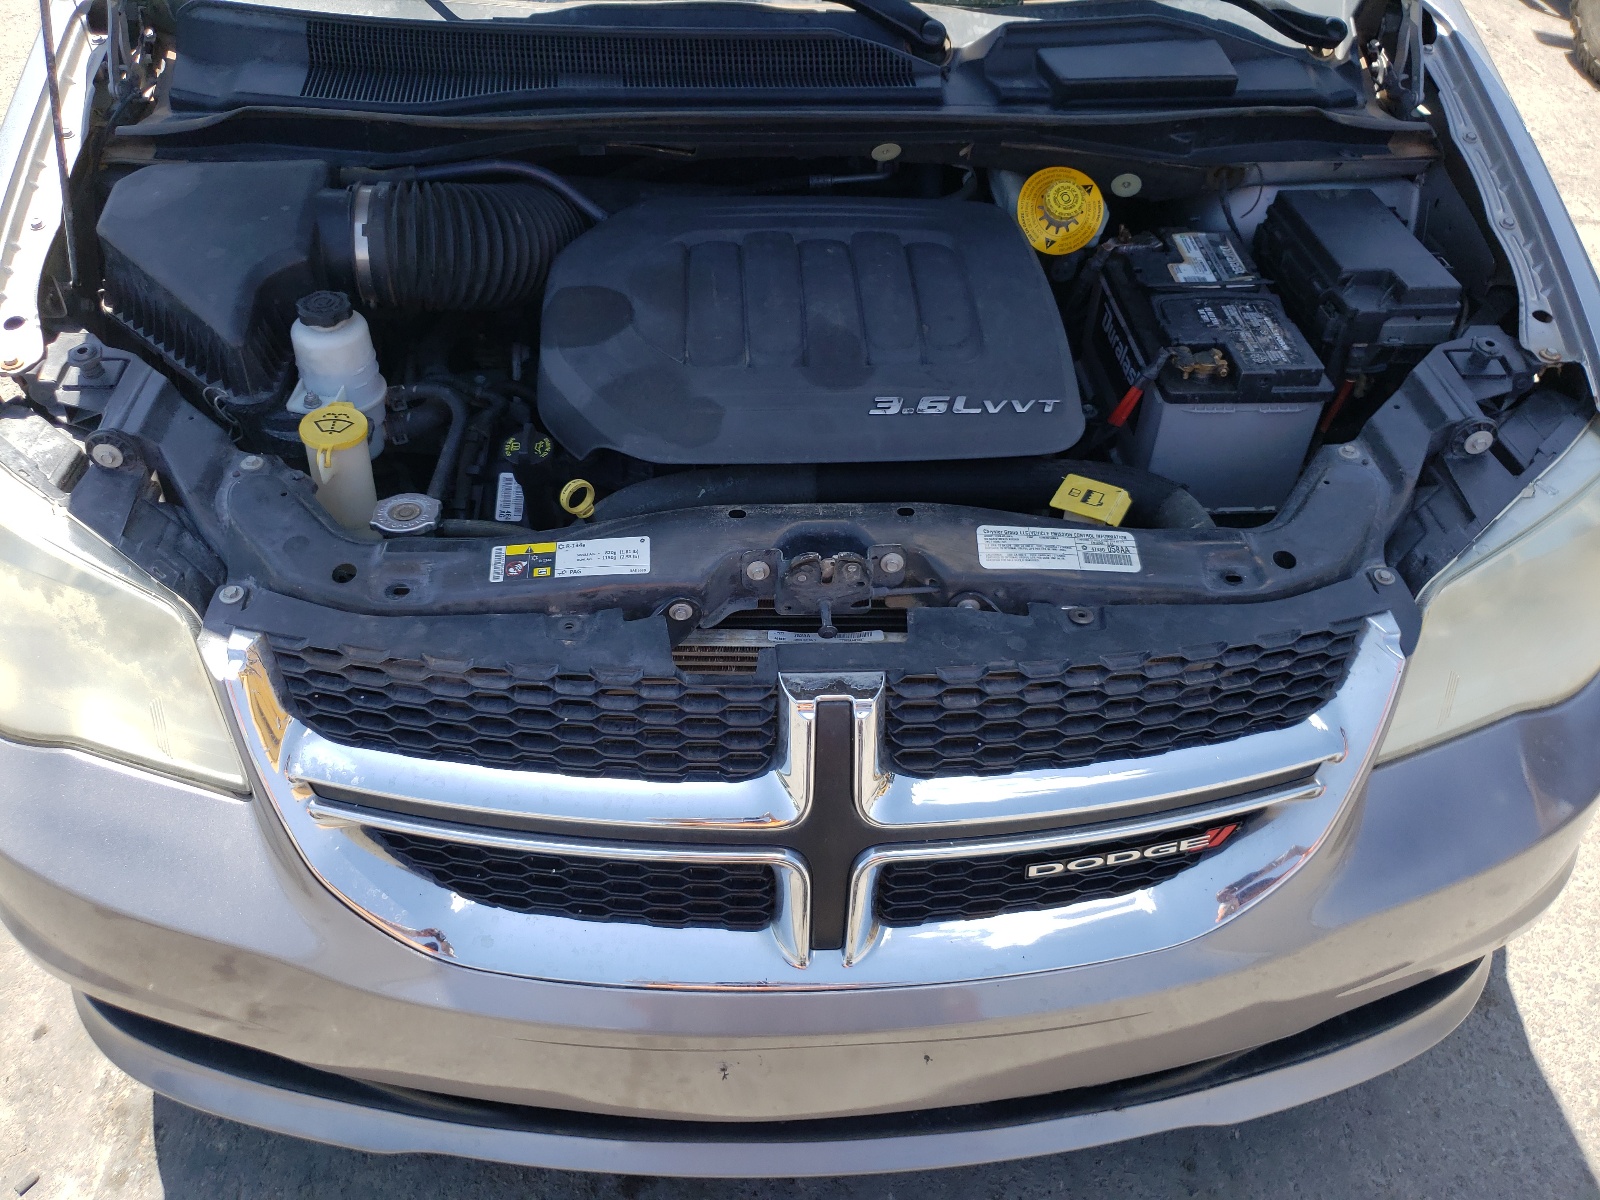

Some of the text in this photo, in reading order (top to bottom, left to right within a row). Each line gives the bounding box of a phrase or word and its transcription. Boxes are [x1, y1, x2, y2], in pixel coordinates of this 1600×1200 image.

[869, 395, 1061, 415] 3.6L VVT
[1028, 834, 1211, 877] DODGE
